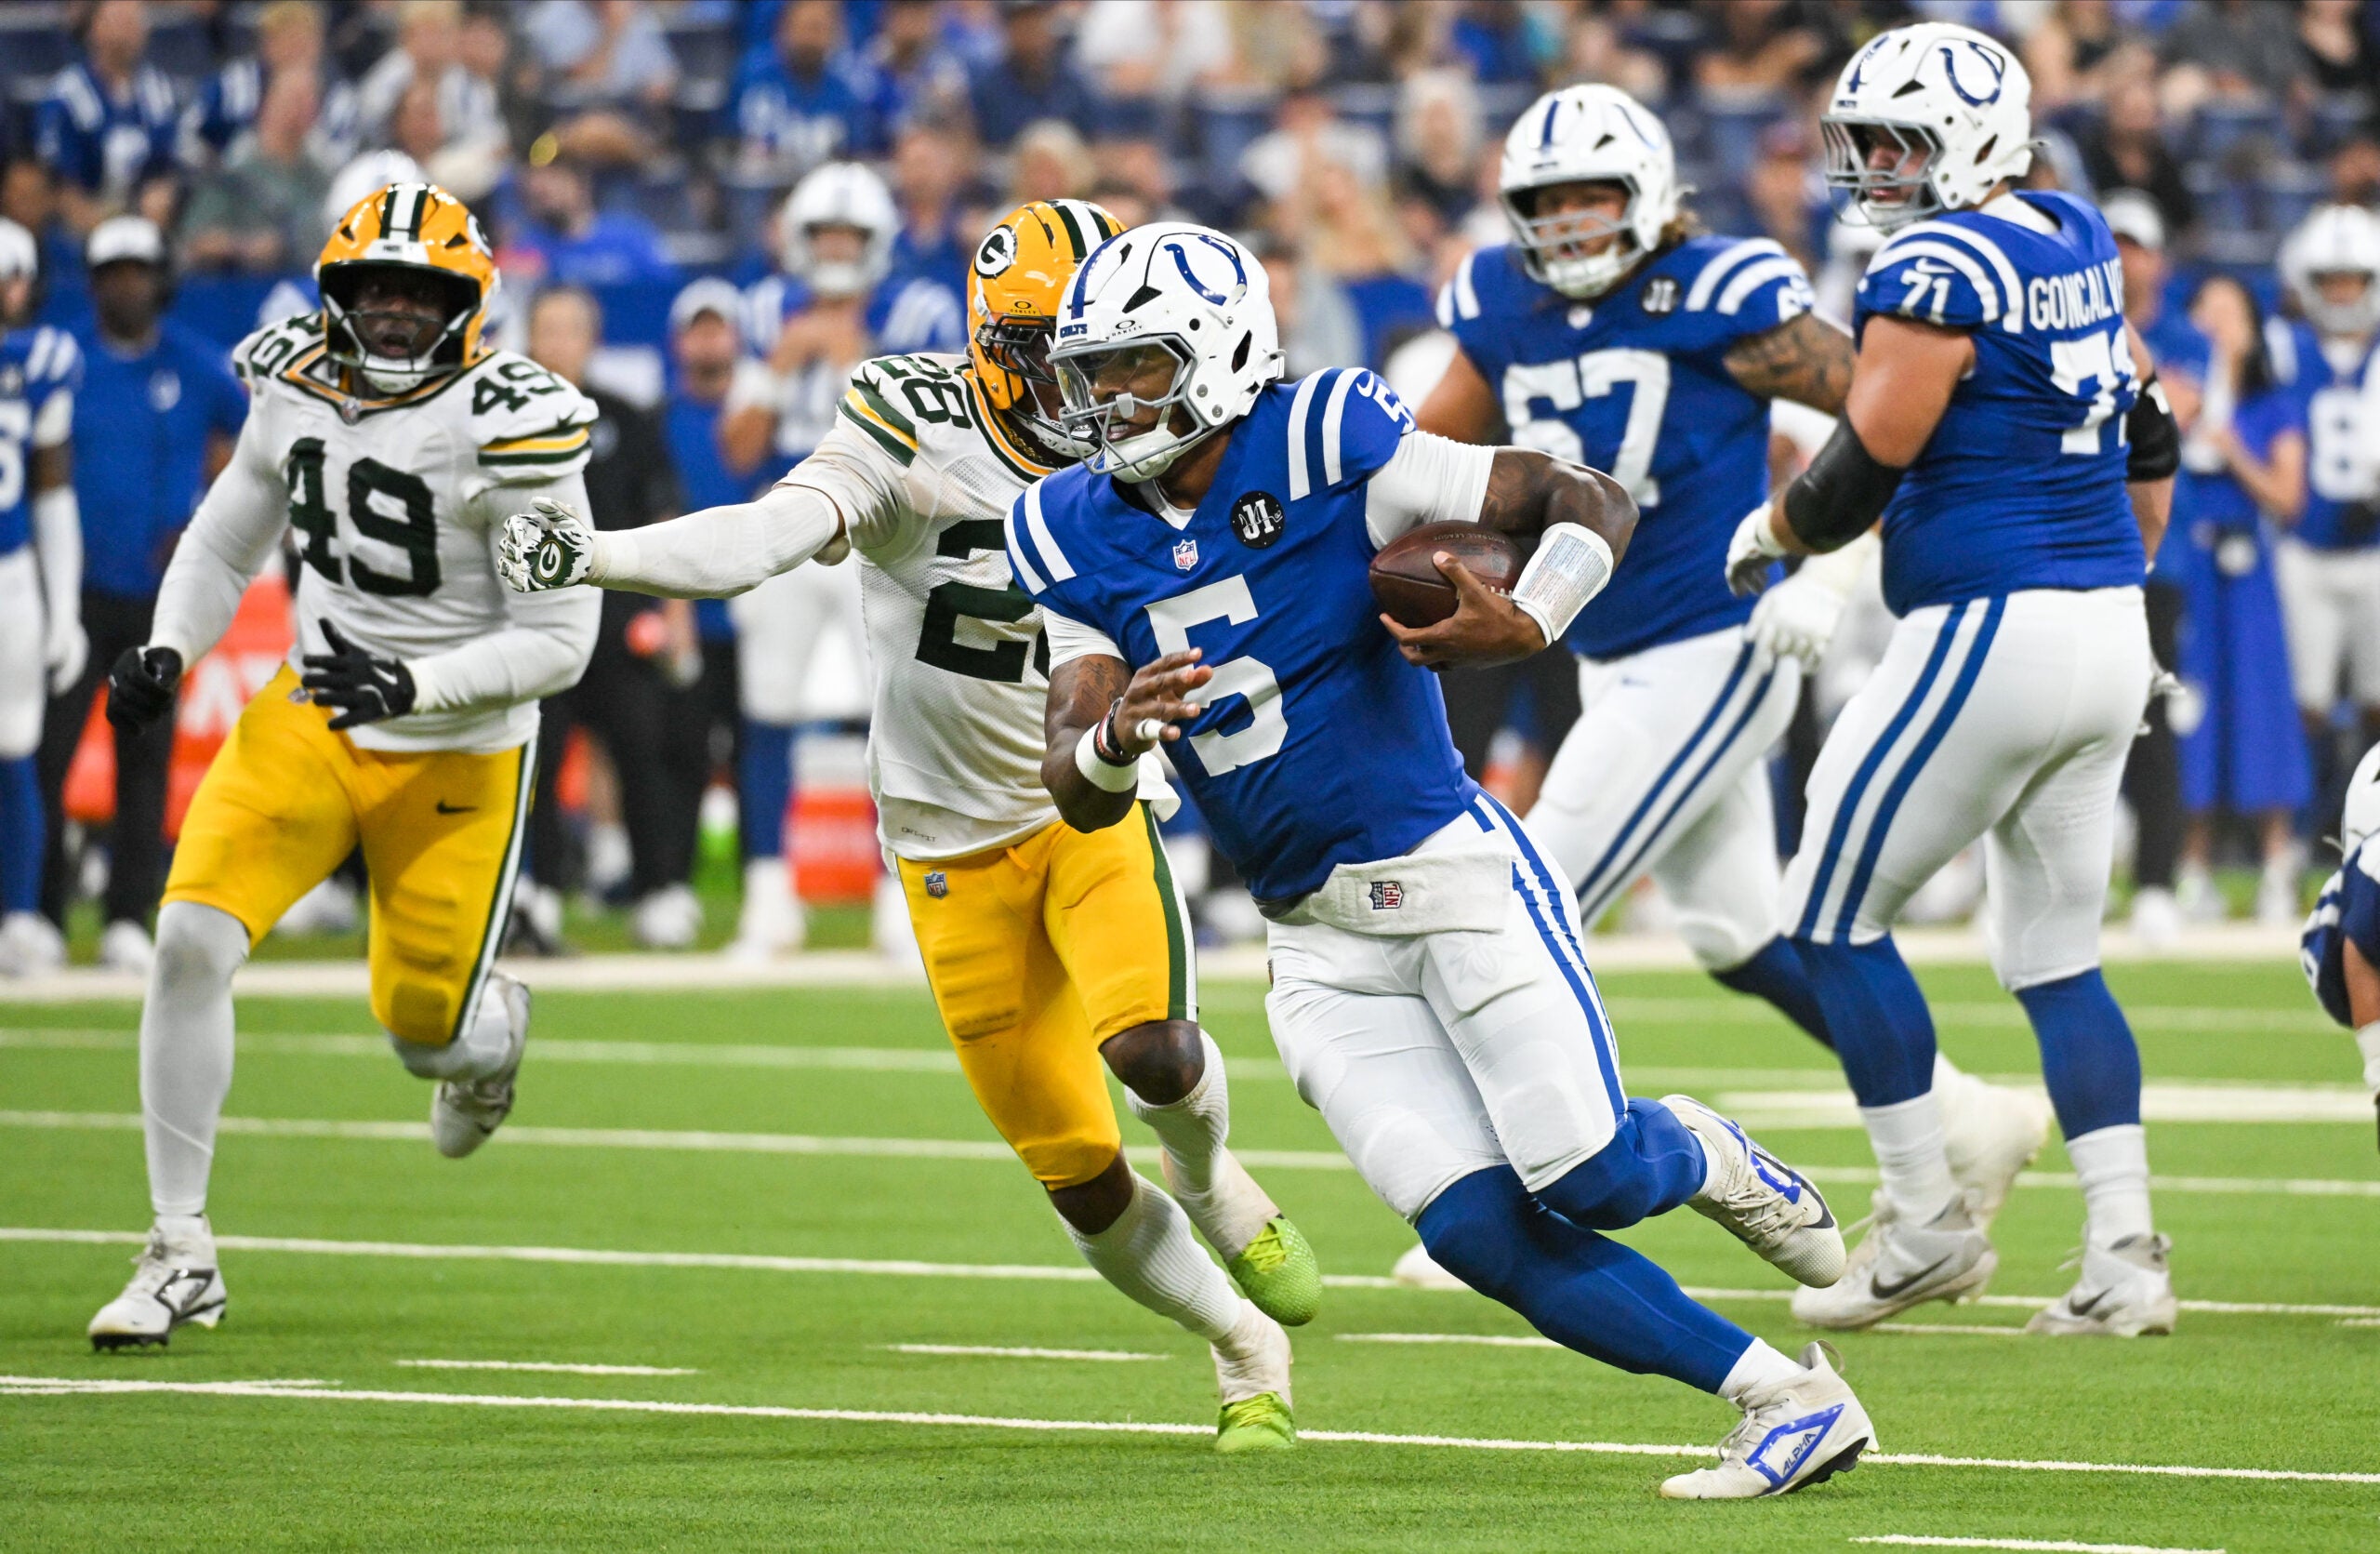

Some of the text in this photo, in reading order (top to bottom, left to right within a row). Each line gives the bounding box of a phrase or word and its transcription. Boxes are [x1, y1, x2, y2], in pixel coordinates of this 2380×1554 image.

[975, 227, 1014, 275] G
[1897, 270, 1950, 325] 71
[1060, 323, 1088, 339] COLTS
[1111, 325, 1143, 337] OAKLEY
[471, 361, 565, 416] 49
[1373, 383, 1415, 433] 5
[1503, 348, 1670, 507] 67
[288, 437, 442, 596] 49
[538, 541, 562, 579] G
[916, 519, 1049, 683] 2
[1144, 574, 1289, 777] 5
[1782, 1433, 1817, 1476] ALPHA
